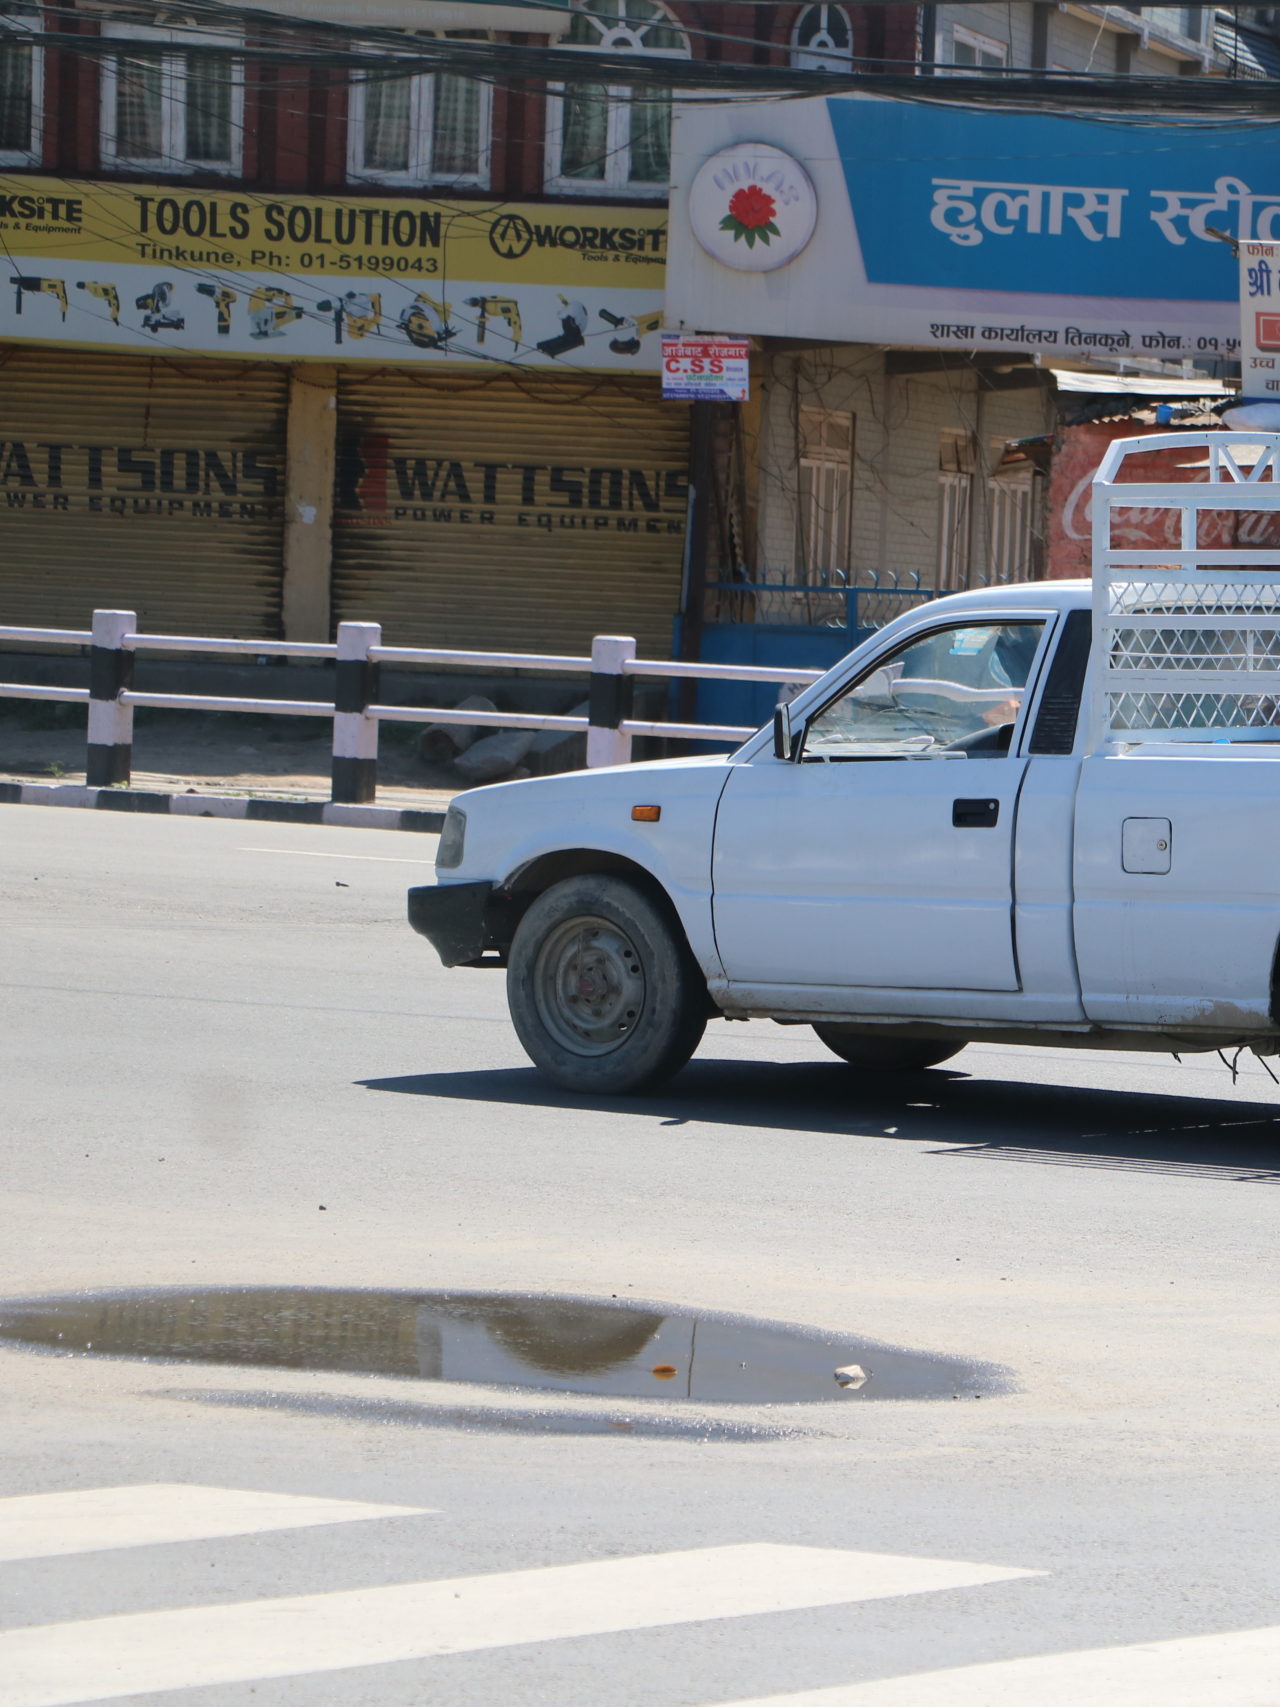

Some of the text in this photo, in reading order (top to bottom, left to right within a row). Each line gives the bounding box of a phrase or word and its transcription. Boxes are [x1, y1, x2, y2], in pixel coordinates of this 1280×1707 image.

[134, 196, 442, 248] TOOLS SOLUTION
[930, 178, 1128, 246] हुलास
[25, 222, 82, 235] Equipment
[136, 242, 438, 273] Tinkune, Ph: 01-5199043
[1247, 260, 1272, 297] श्री
[930, 323, 976, 340] शाखा
[981, 326, 1058, 345] कार्यालय
[395, 507, 495, 524] POWER
